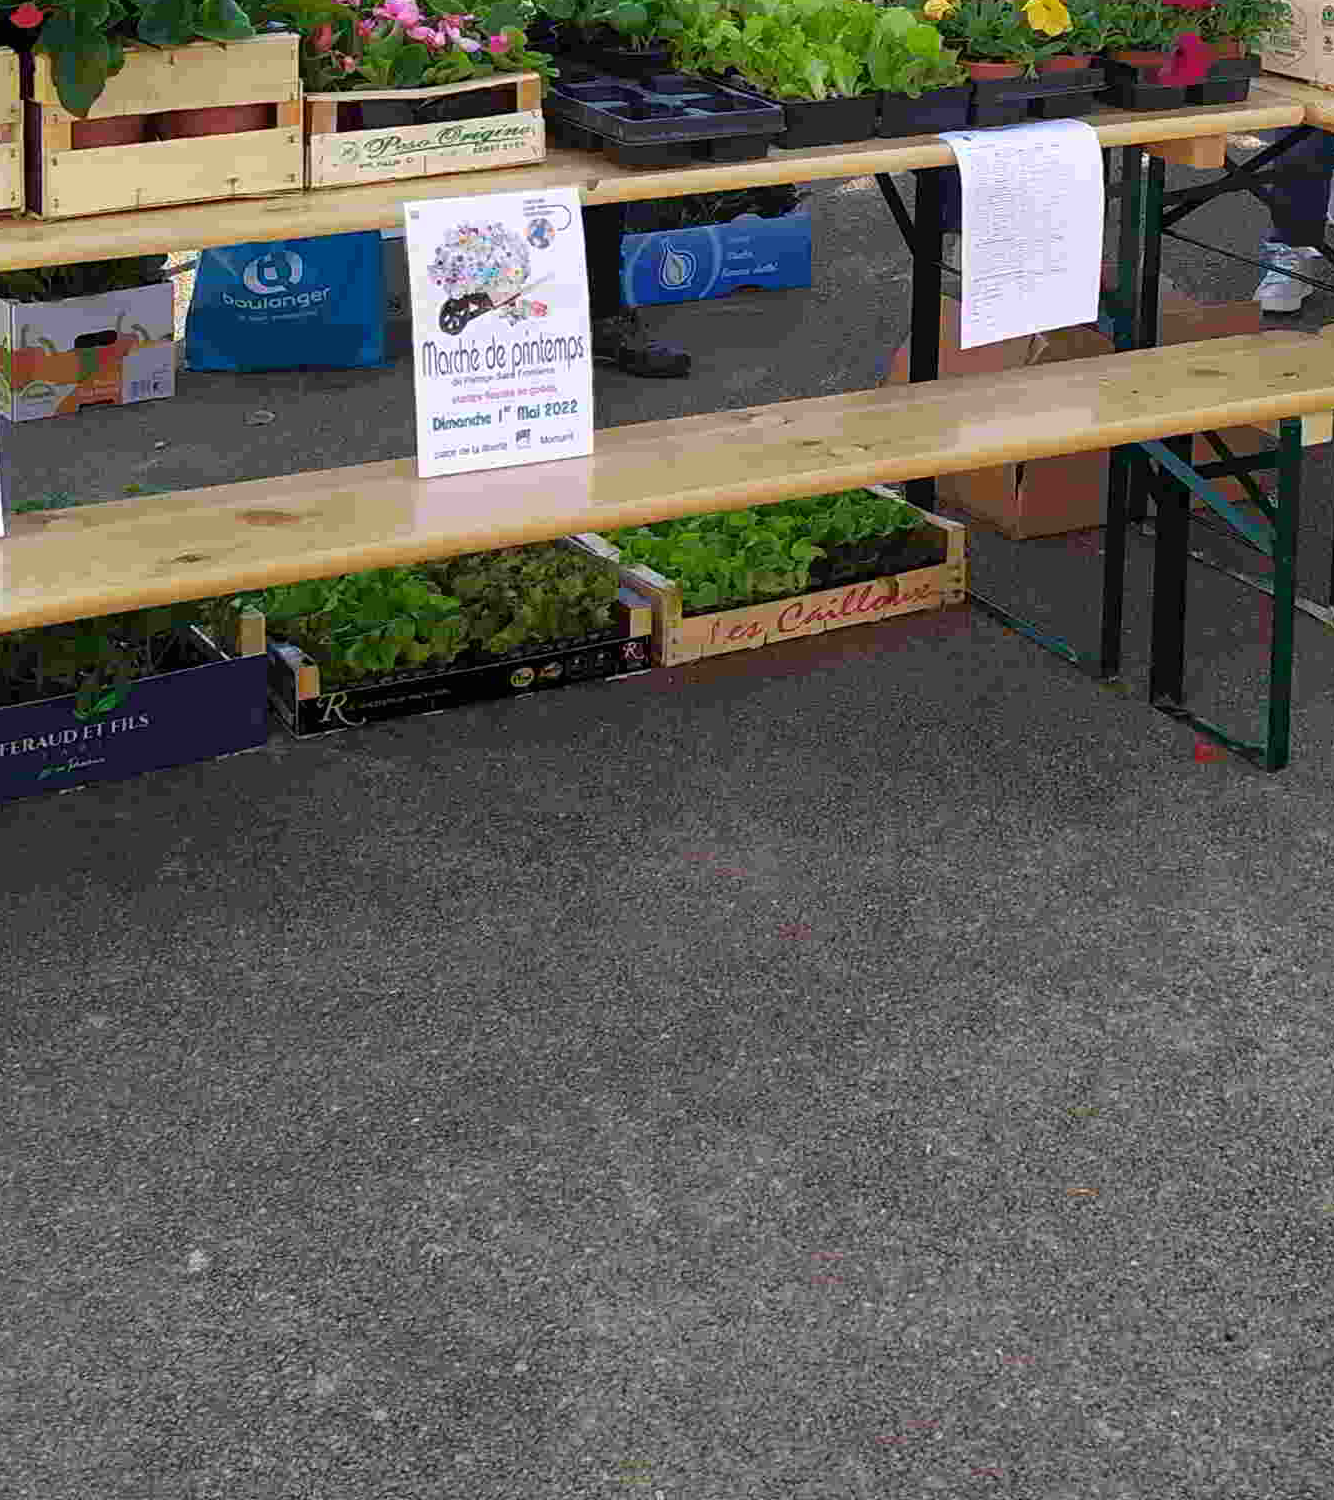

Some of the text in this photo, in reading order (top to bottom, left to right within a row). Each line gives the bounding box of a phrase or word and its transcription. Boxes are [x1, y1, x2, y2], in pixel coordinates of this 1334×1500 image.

[221, 288, 331, 309] boulanger
[422, 330, 584, 378] Marché de printemps
[432, 411, 492, 431] Dimanche
[518, 403, 540, 420] Mai
[545, 398, 578, 417] 2022
[777, 582, 932, 633] Cailloux
[0, 712, 150, 757] FERAUD ET FILS
